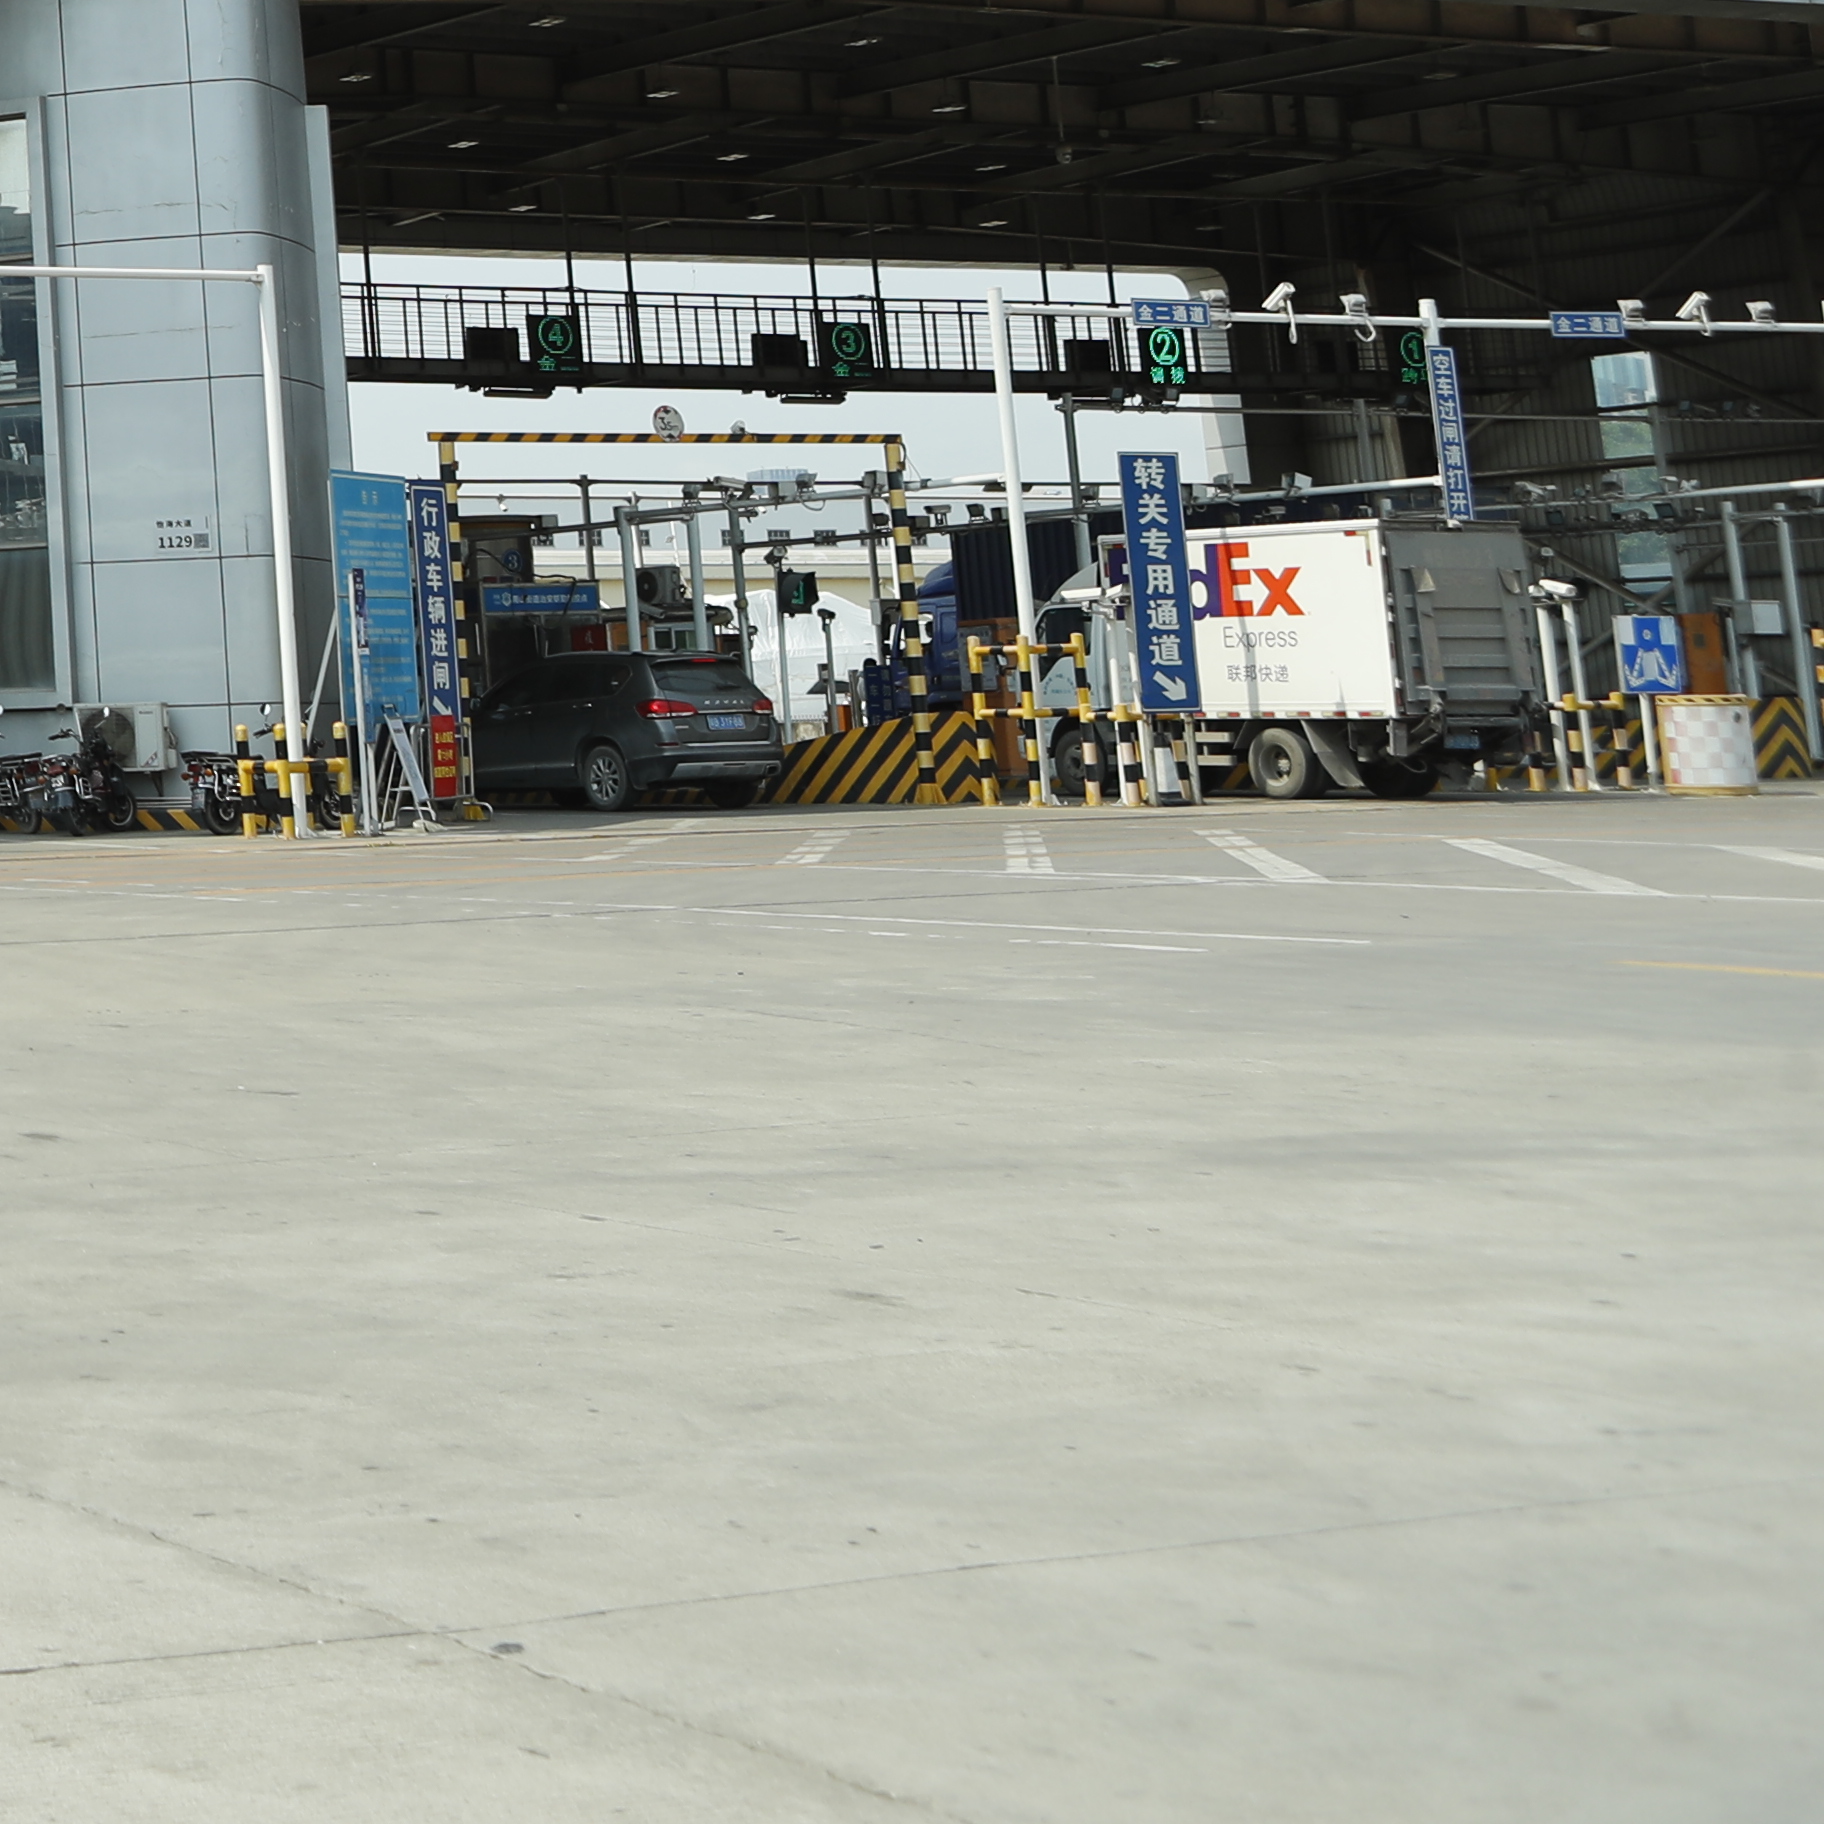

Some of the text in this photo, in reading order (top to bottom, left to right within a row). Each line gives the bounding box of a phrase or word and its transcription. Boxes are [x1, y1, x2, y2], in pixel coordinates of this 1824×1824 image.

[1137, 303, 1205, 323] 金二通道
[548, 323, 564, 347] 4
[1556, 316, 1620, 333] 金二通道
[841, 330, 857, 353] 3
[1156, 333, 1173, 360] 2
[1408, 338, 1419, 360] 1
[159, 536, 192, 548] 1129
[508, 556, 518, 569] 3
[1132, 457, 1183, 666] 转关专用通道
[420, 497, 450, 691] 行政车辆进闸
[1223, 626, 1299, 652] Express
[1226, 664, 1290, 683] 联邦快递
